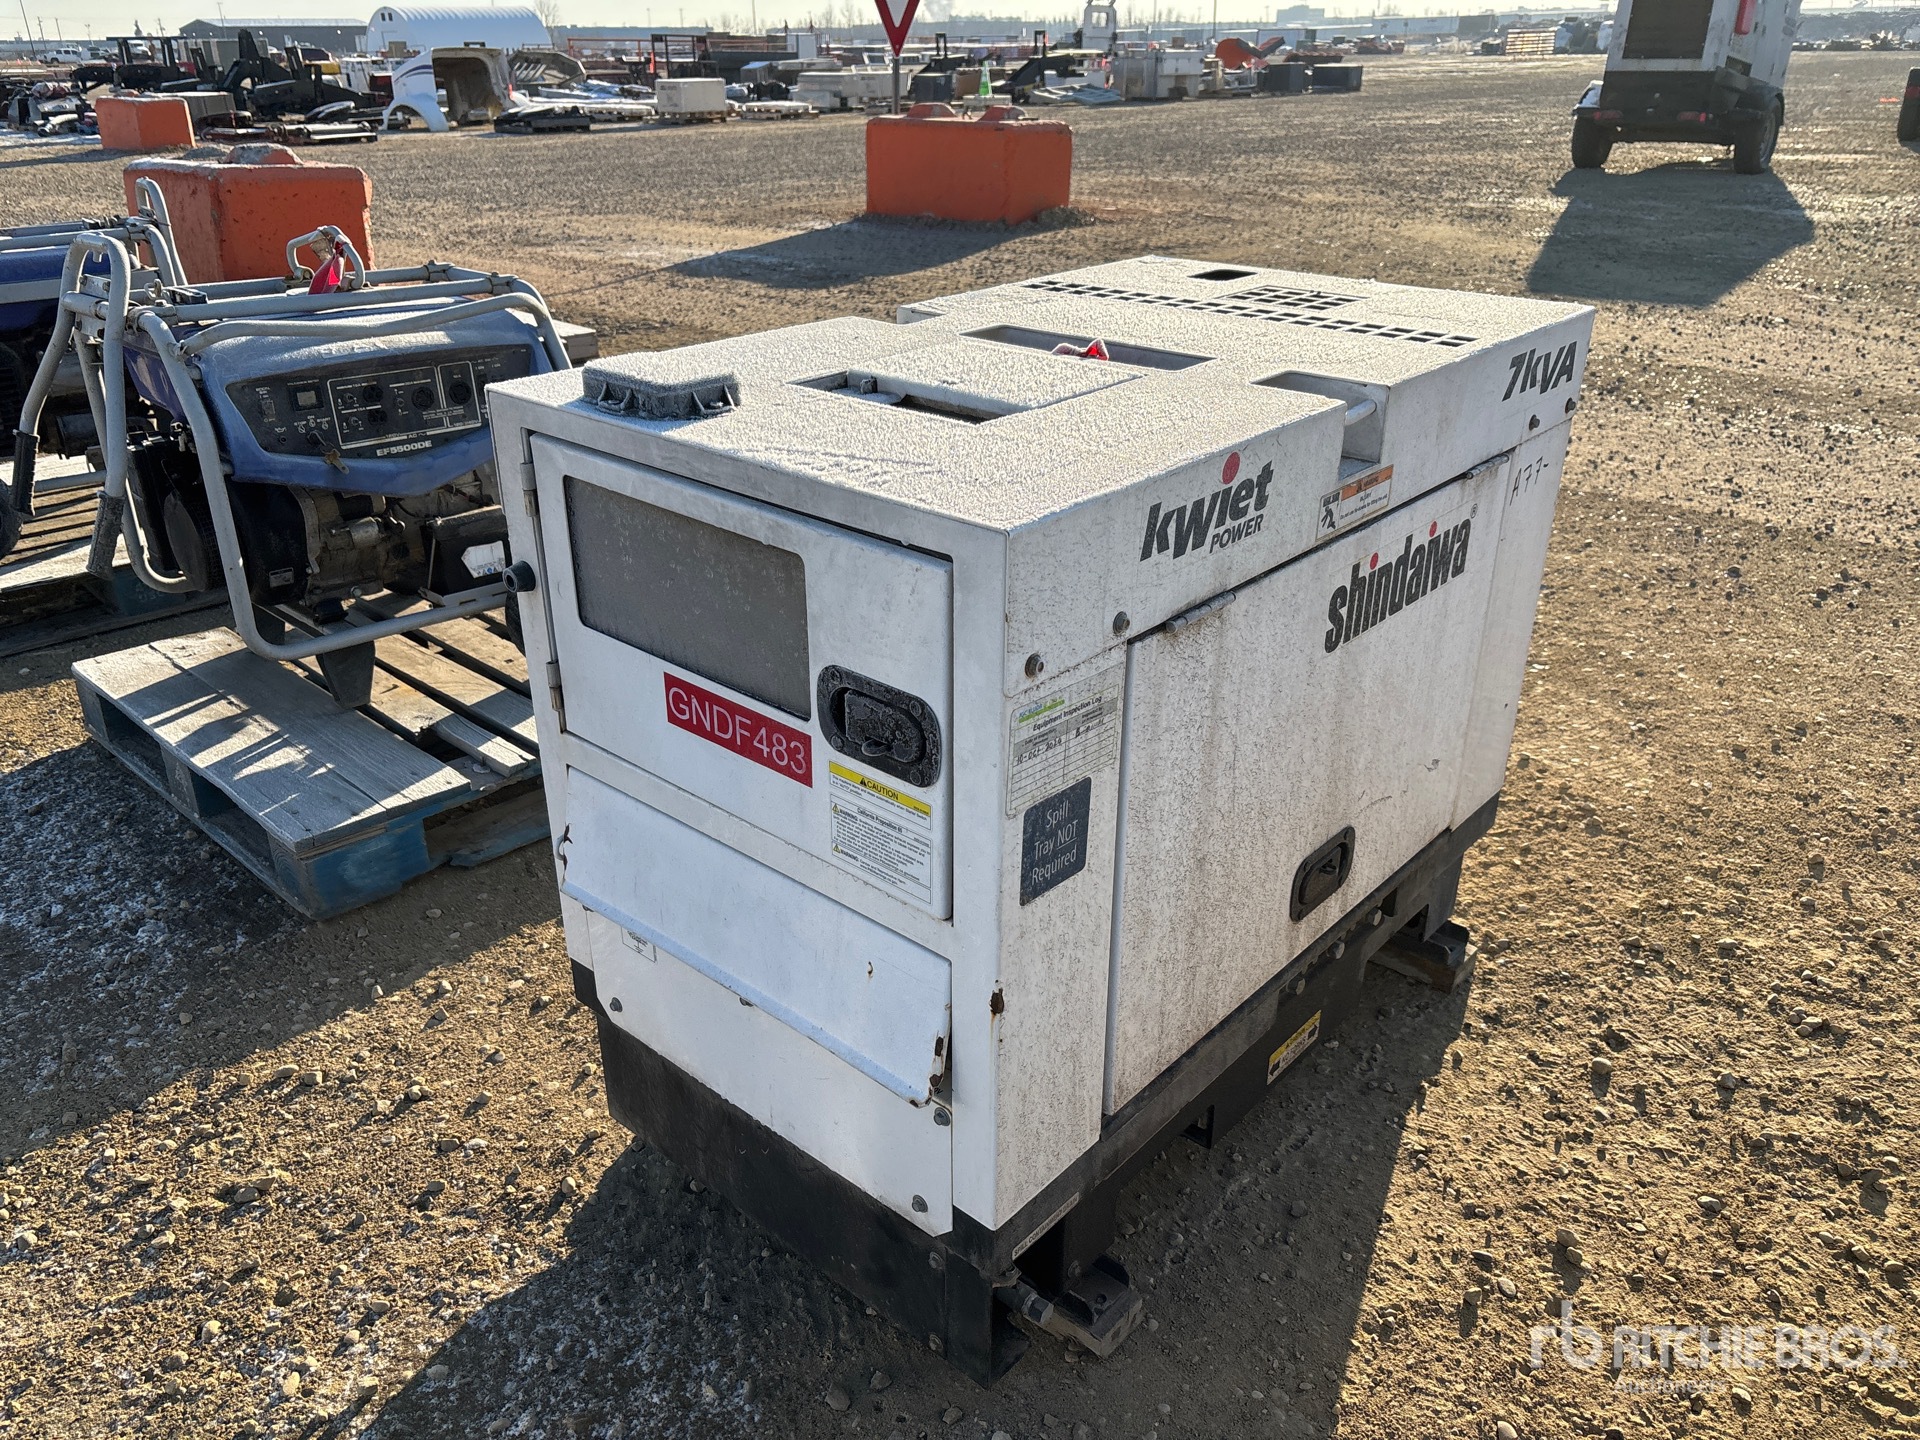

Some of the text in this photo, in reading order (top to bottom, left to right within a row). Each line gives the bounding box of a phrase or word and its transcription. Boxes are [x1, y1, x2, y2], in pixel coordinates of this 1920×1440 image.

[1502, 341, 1577, 402] 7kVA
[376, 440, 433, 457] EF5500DE
[1140, 452, 1274, 562] kwiet
[1209, 513, 1264, 554] POWER
[1324, 519, 1472, 653] shindaiwa
[668, 687, 807, 774] GNDF483
[1033, 714, 1063, 732] Equipment
[1063, 700, 1091, 718] Inspection
[1091, 696, 1103, 705] Log
[866, 780, 899, 801] CAUTION
[856, 806, 875, 821] California
[1045, 800, 1069, 828] Spill
[1034, 819, 1079, 860] Tray NOT
[1031, 844, 1077, 886] Required
